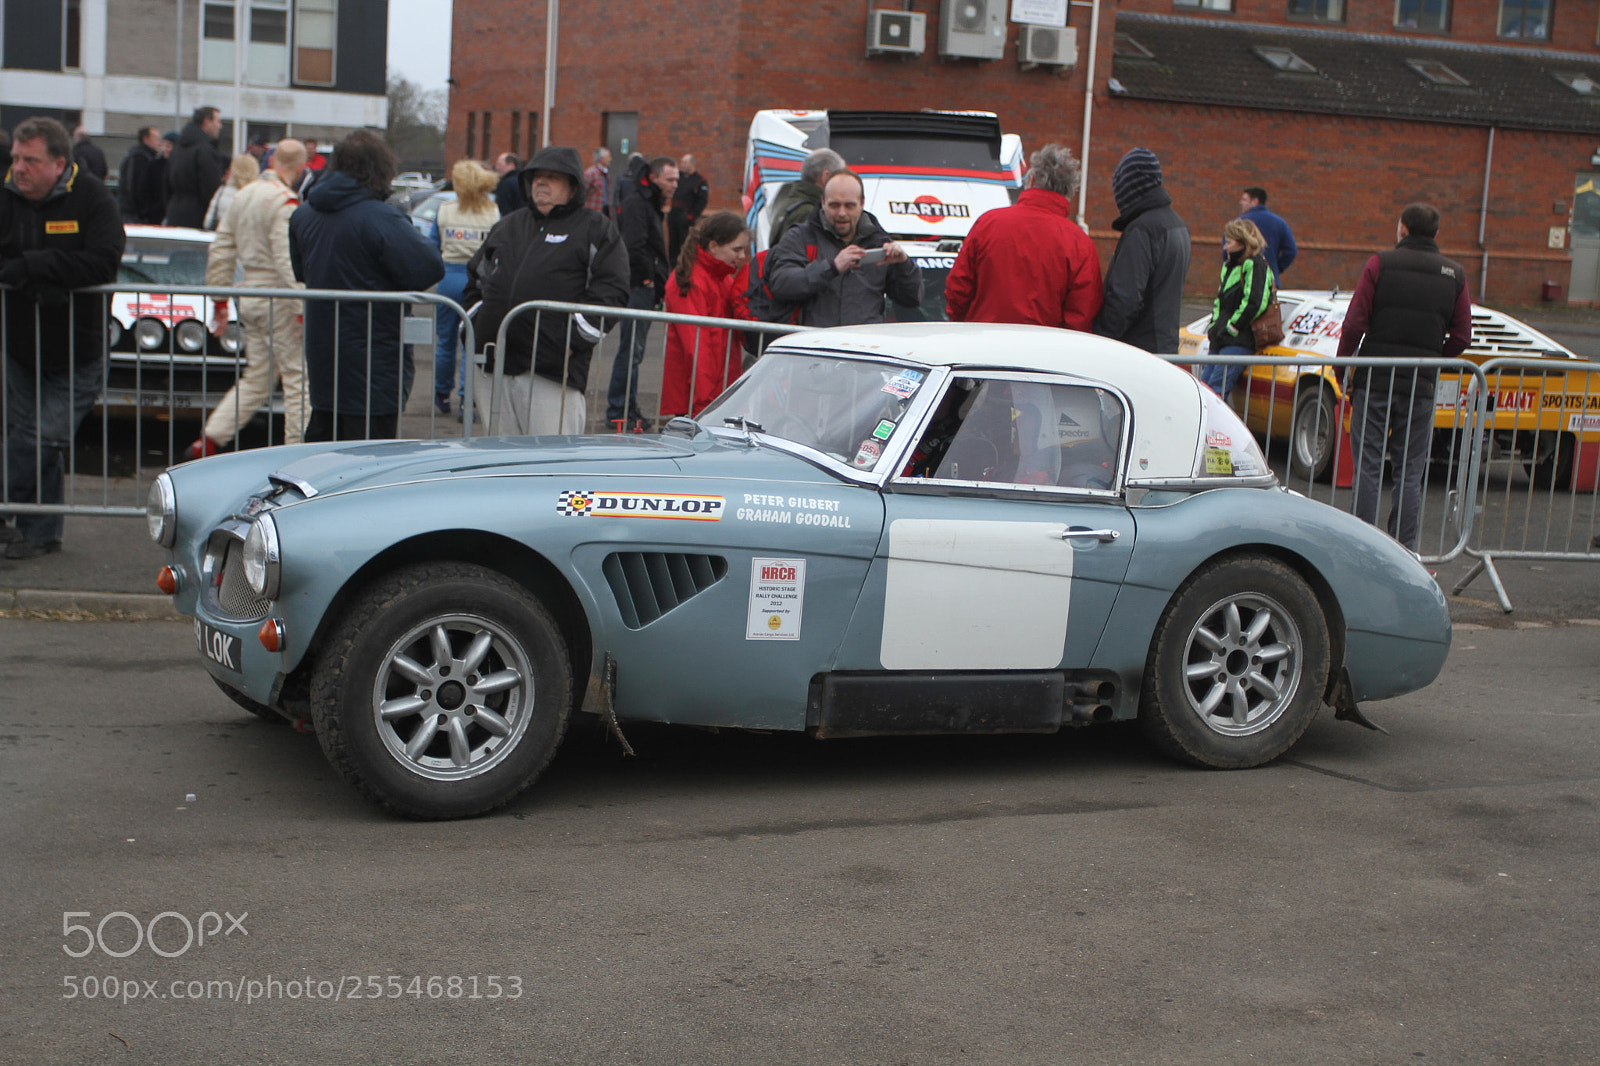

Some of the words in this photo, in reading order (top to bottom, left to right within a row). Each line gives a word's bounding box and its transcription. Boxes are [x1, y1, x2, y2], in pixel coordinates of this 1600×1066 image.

[891, 202, 968, 217] MARTINI
[446, 229, 478, 240] Mobil
[1487, 390, 1536, 412] LANT
[597, 497, 722, 513] DUNLOP
[743, 493, 784, 507] PETER
[788, 497, 840, 512] GILBERT
[736, 508, 791, 524] GRAHAM
[796, 512, 851, 529] GOODALL
[762, 567, 796, 580] HRCR
[205, 625, 235, 670] LOK
